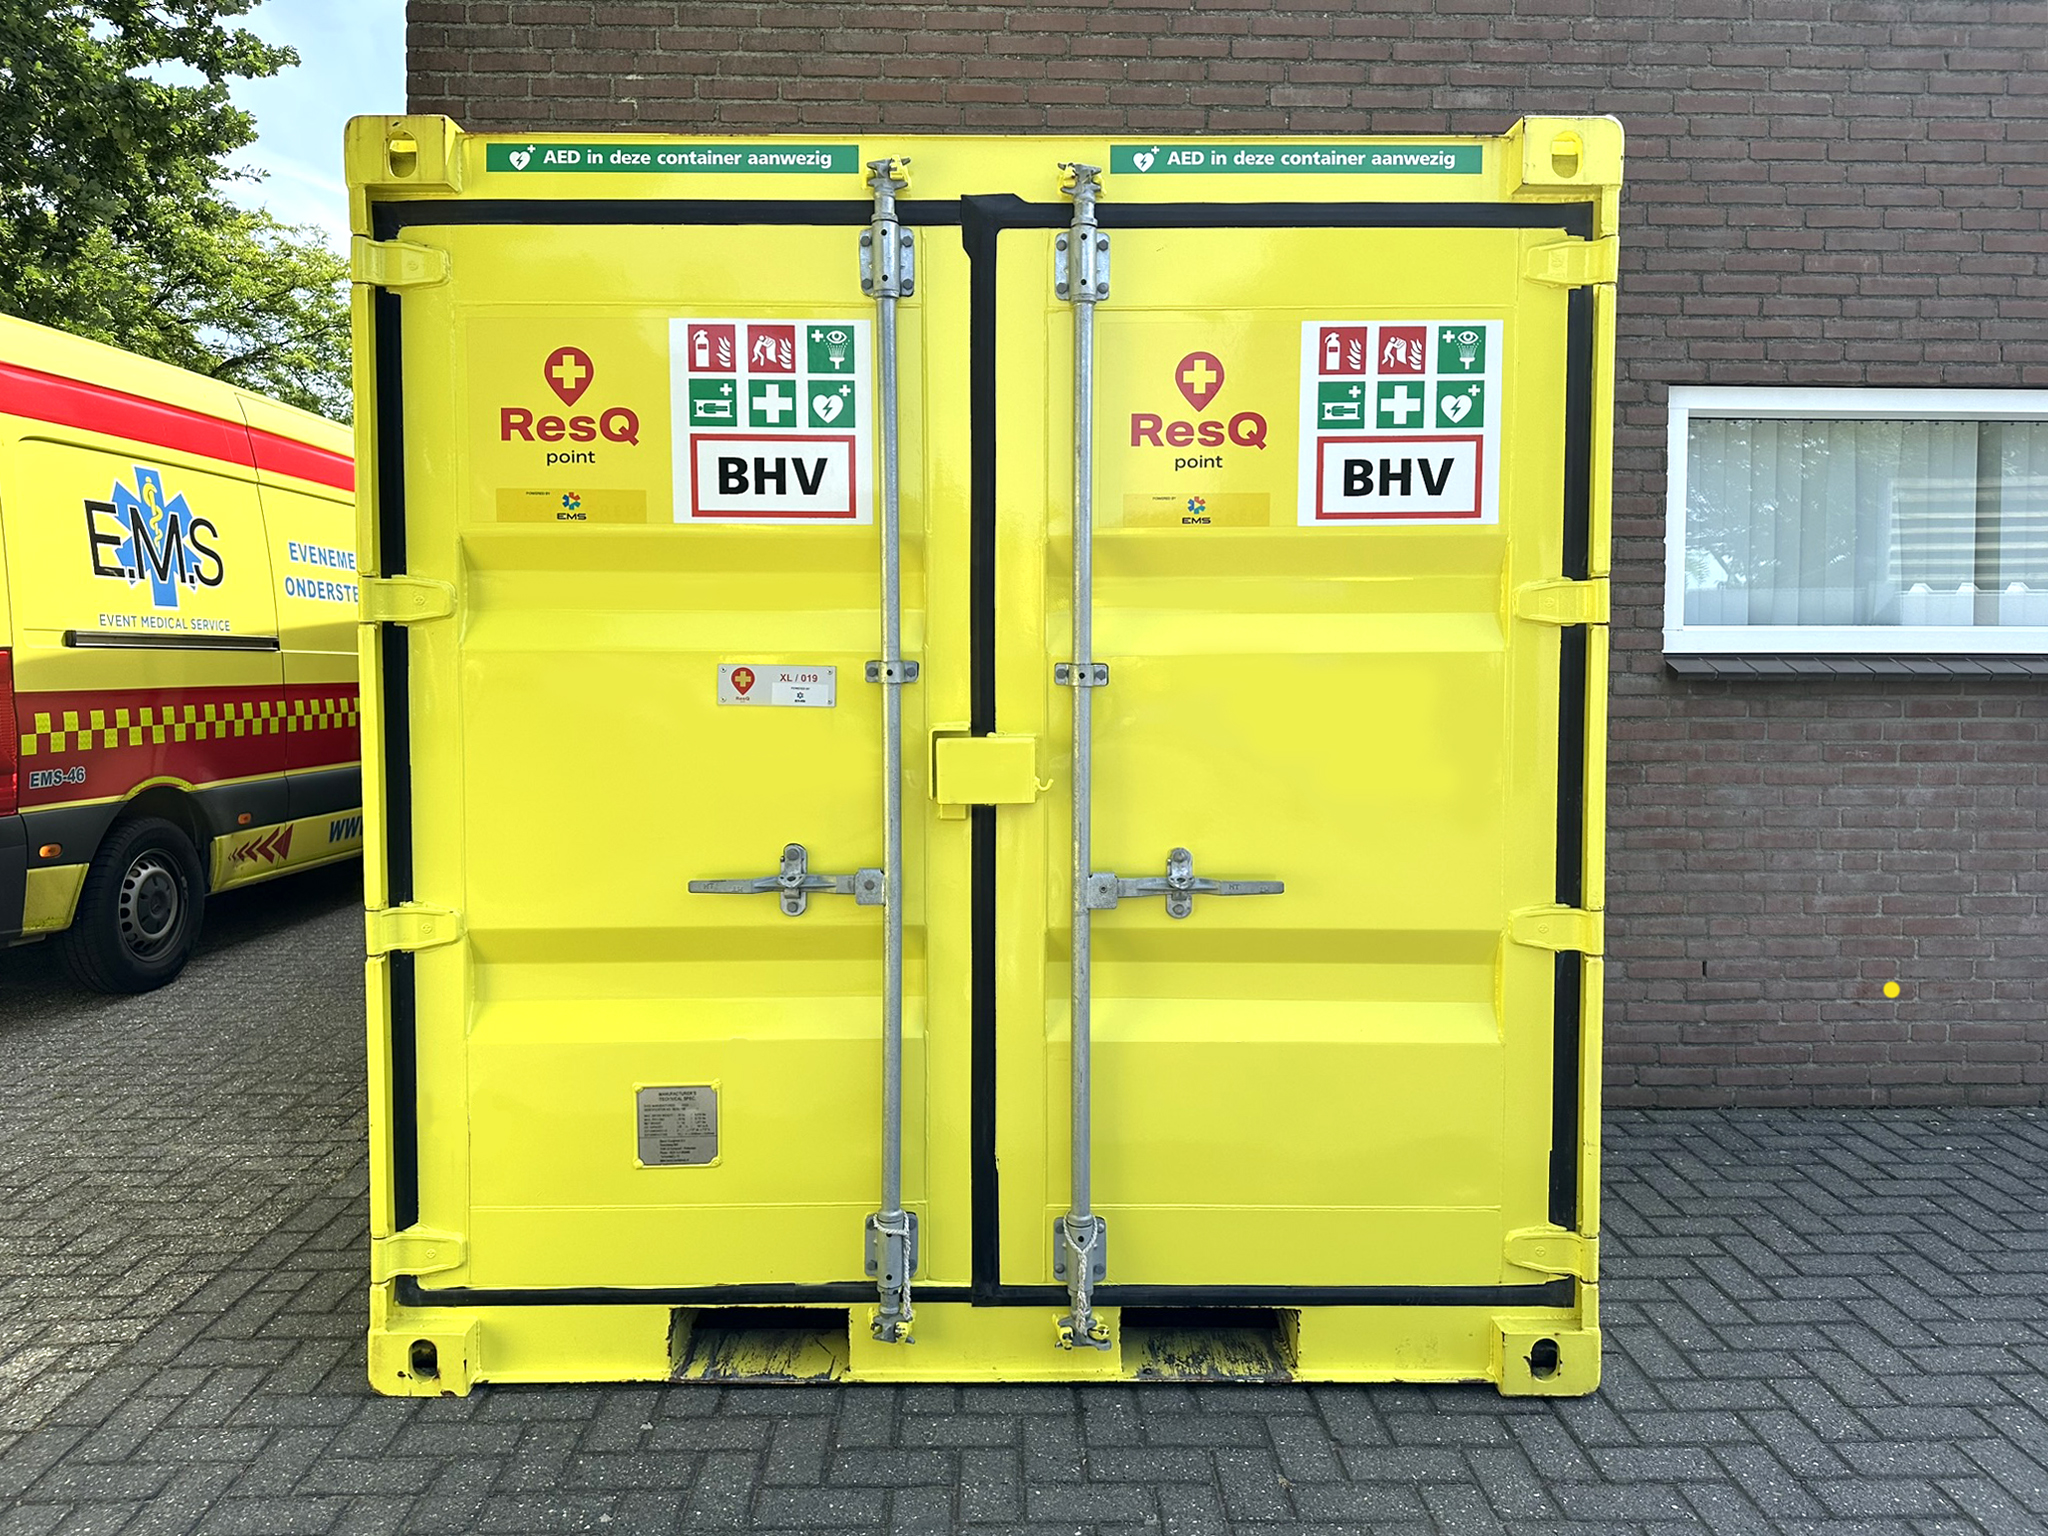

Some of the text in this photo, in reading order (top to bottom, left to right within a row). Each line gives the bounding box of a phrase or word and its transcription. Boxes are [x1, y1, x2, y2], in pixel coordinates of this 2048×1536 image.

[543, 149, 832, 169] AED in deze container aanwezig
[1167, 150, 1456, 169] AED in deze container aanwezig
[500, 407, 640, 447] ResQ
[1130, 411, 1268, 451] ResQ
[546, 450, 596, 467] point
[1174, 455, 1223, 472] point
[717, 456, 829, 496] BHV
[1342, 457, 1455, 497] BHV
[556, 512, 587, 521] EMS
[1181, 516, 1212, 525] EMS
[99, 613, 231, 632] EVENT MEDICAL SERVICE
[780, 673, 793, 682] XL
[800, 673, 818, 683] 019
[29, 766, 86, 789] EMS-46
